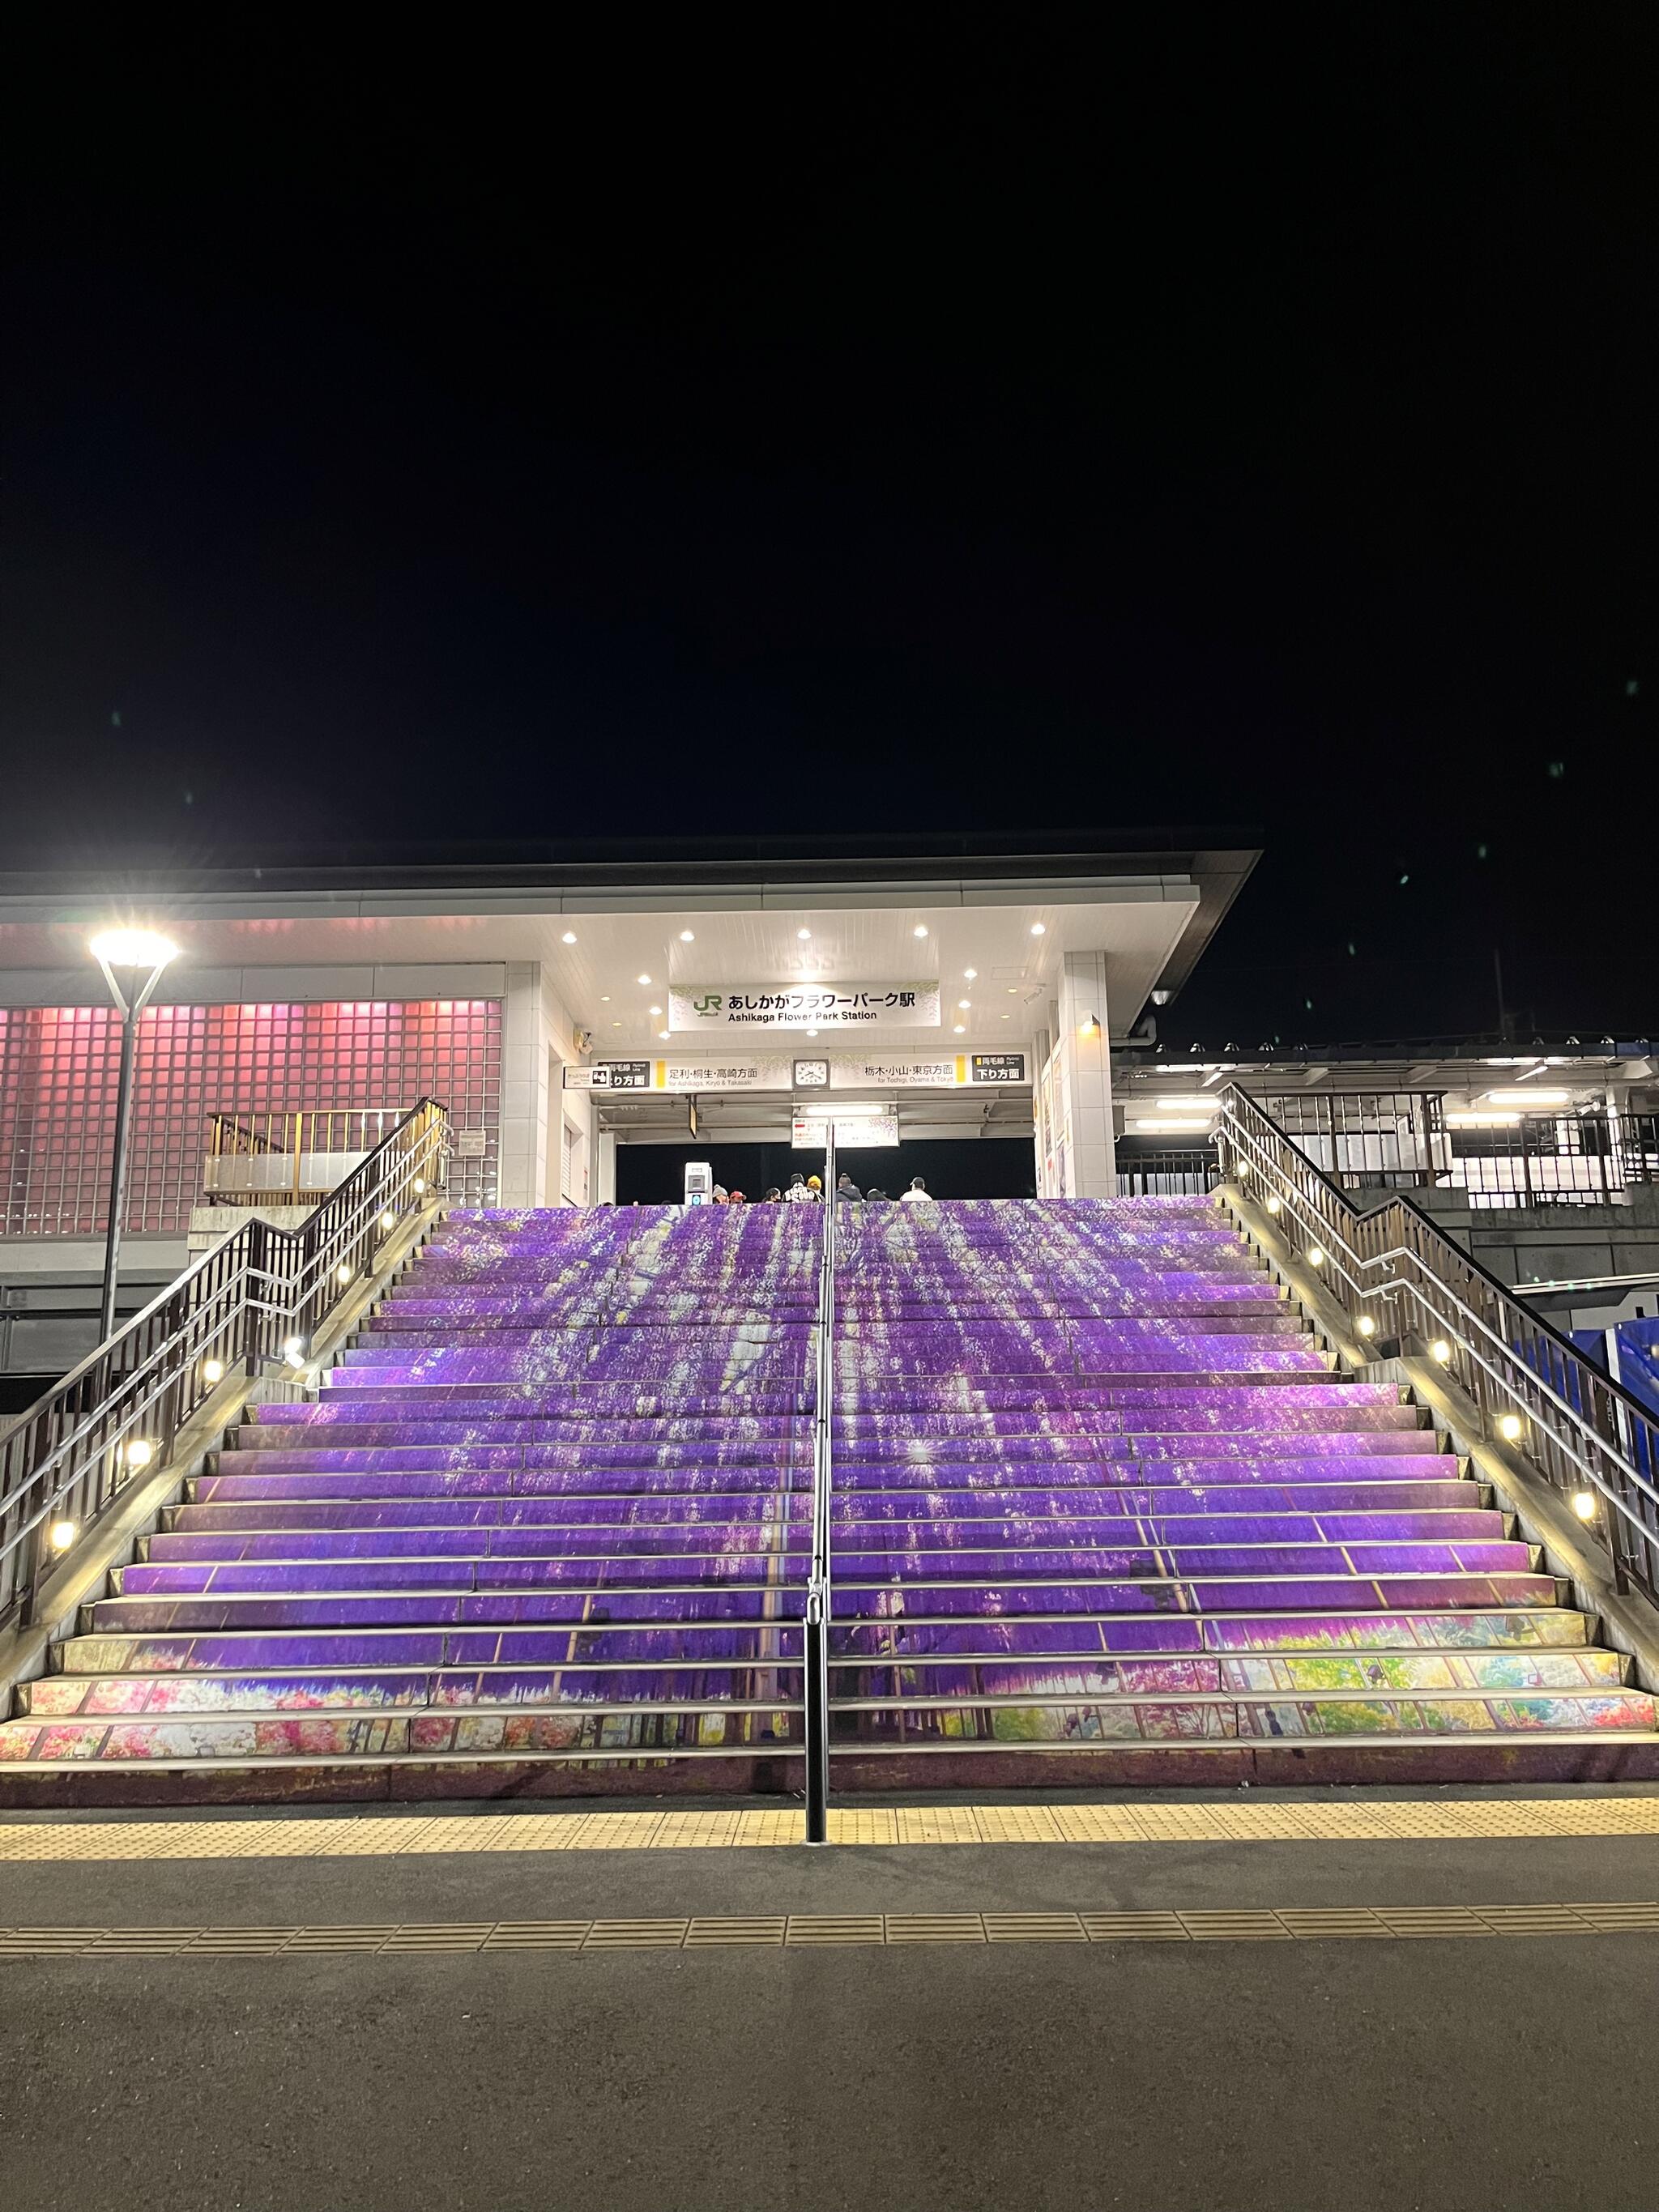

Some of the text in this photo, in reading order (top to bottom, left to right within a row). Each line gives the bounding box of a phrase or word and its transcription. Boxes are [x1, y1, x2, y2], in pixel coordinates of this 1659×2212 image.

[693, 995, 723, 1012] JR
[728, 992, 915, 1010] あしかがフラワーパーク駅
[728, 1013, 775, 1023] Ashikaga
[778, 1012, 812, 1021] Flower
[816, 1012, 839, 1021] Park
[842, 1011, 877, 1021] Station
[977, 1068, 1019, 1080] 下り方面
[609, 1075, 646, 1086] り方面
